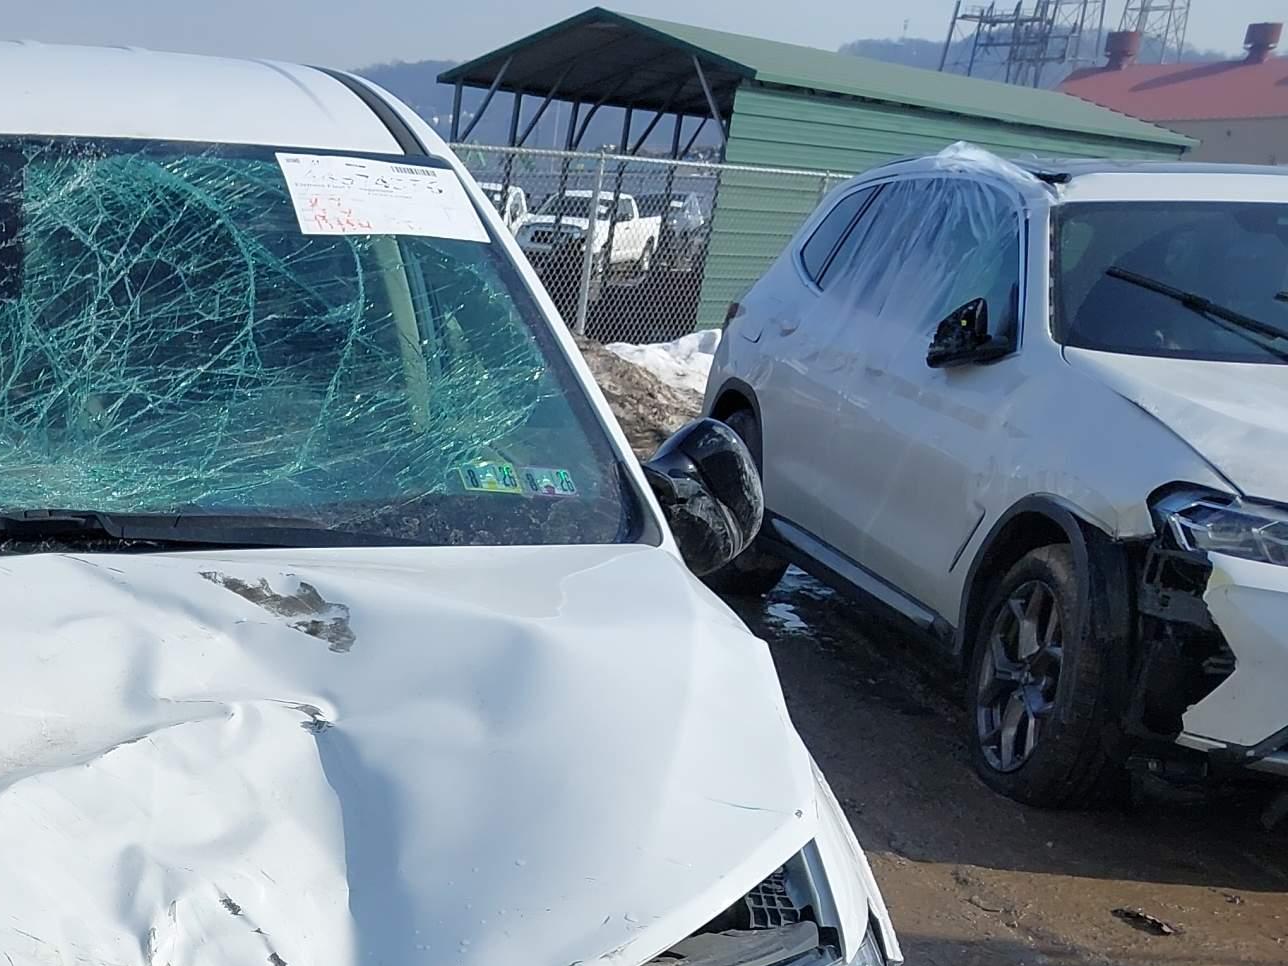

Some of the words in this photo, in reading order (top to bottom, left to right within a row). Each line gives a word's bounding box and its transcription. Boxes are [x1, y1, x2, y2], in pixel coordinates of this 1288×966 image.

[466, 469, 479, 488] 8
[499, 465, 518, 488] 26
[526, 473, 538, 492] 8
[556, 470, 576, 492] 26
